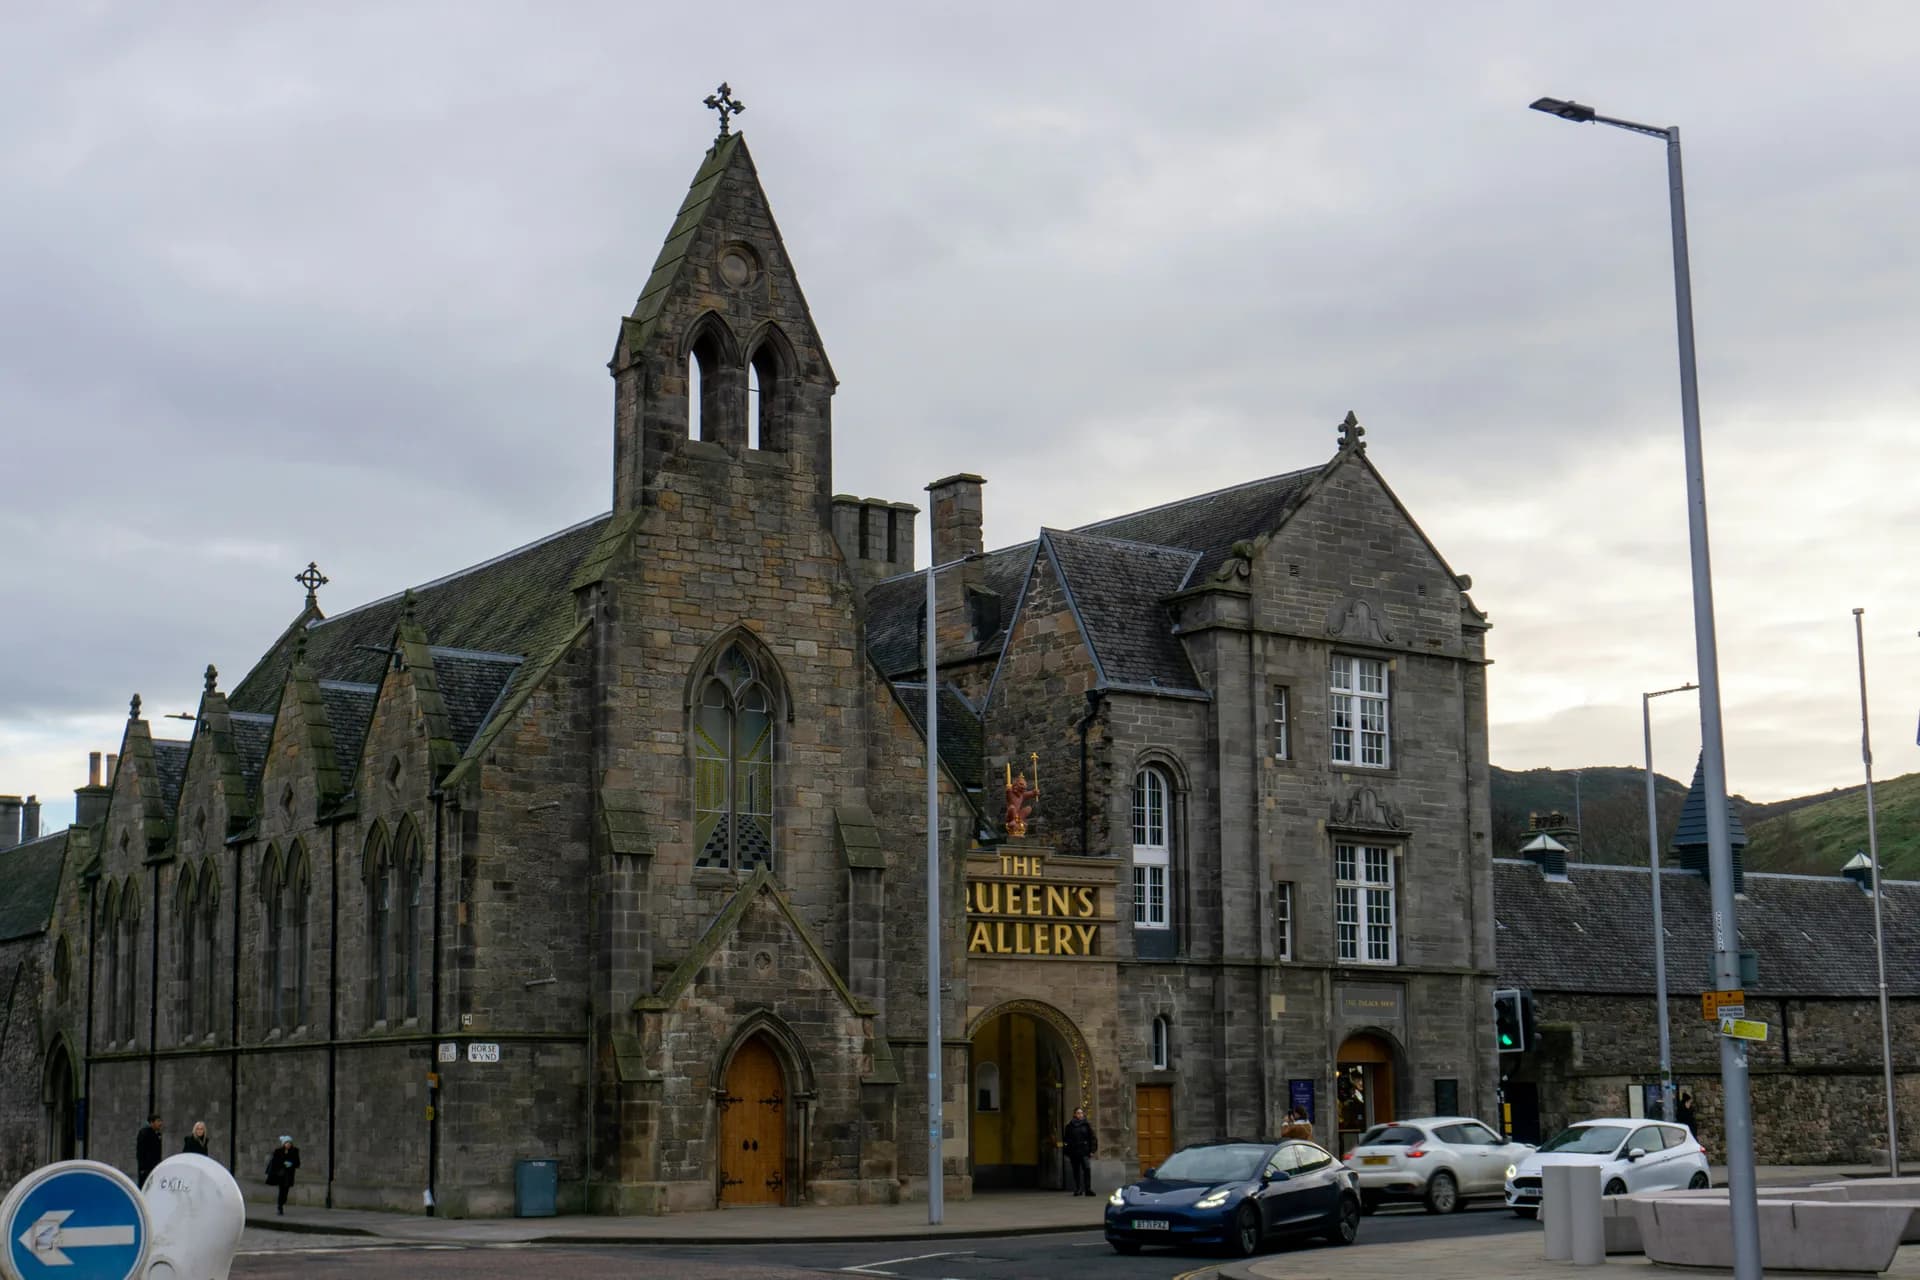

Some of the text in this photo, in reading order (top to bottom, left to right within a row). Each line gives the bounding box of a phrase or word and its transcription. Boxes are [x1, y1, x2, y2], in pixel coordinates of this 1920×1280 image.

[1000, 855, 1042, 876] THE
[966, 882, 1094, 917] UEEN'S
[968, 922, 1097, 955] ALLERY
[471, 1044, 497, 1053] HORSE
[471, 1053, 497, 1061] WYND
